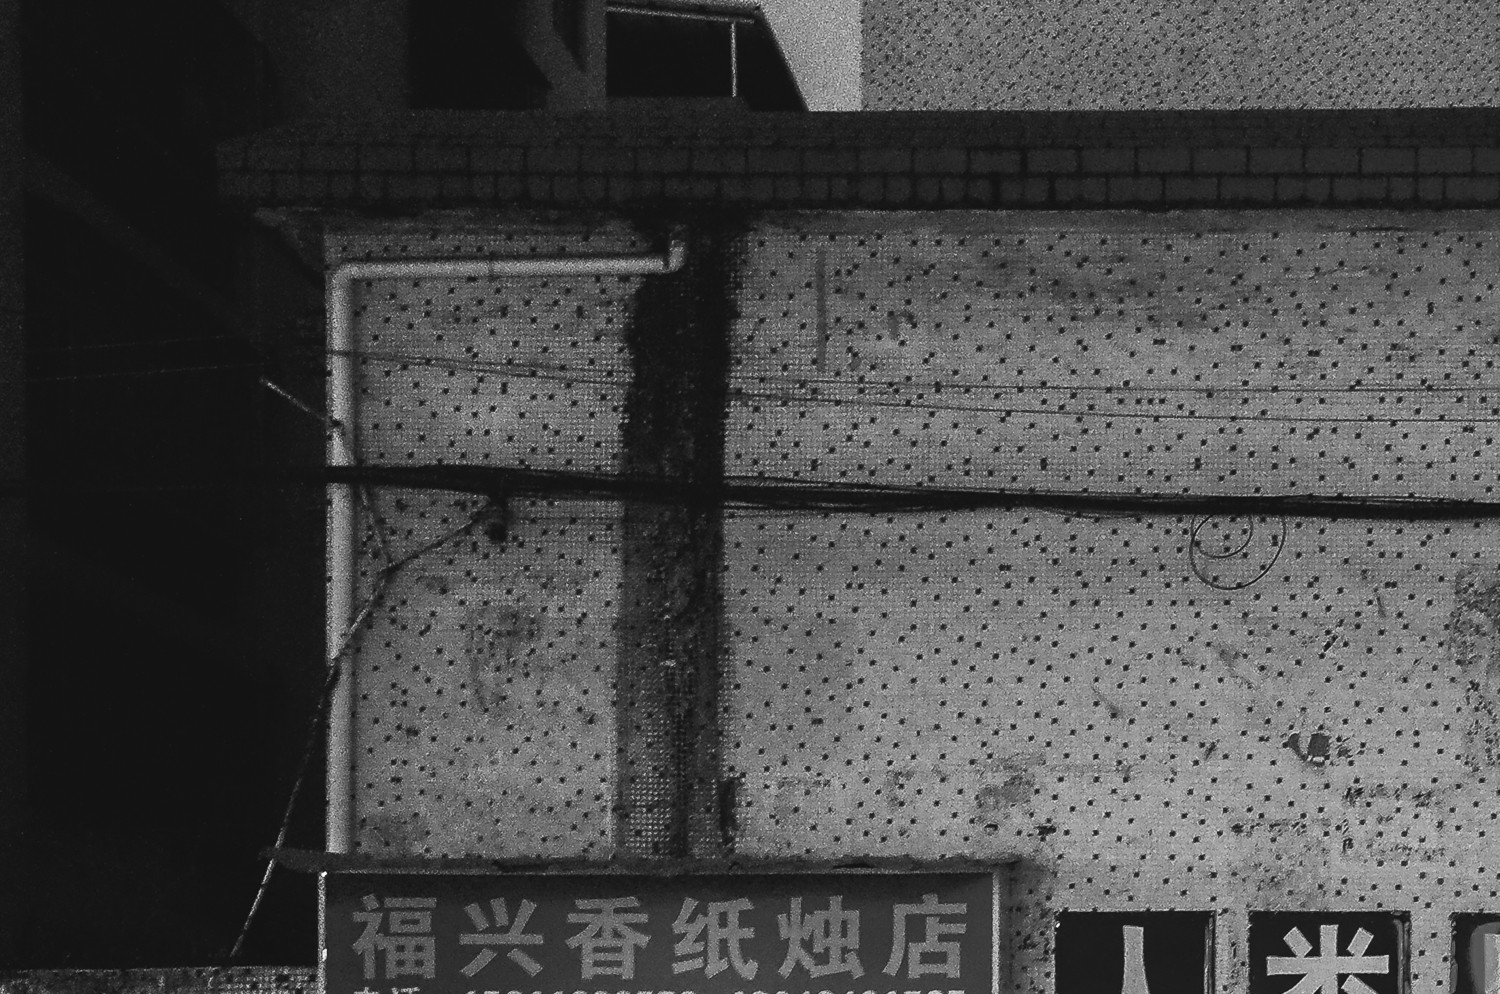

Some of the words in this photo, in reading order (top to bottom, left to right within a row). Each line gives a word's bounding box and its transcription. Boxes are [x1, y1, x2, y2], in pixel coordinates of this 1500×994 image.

[351, 893, 968, 980] 福兴香纸烛店
